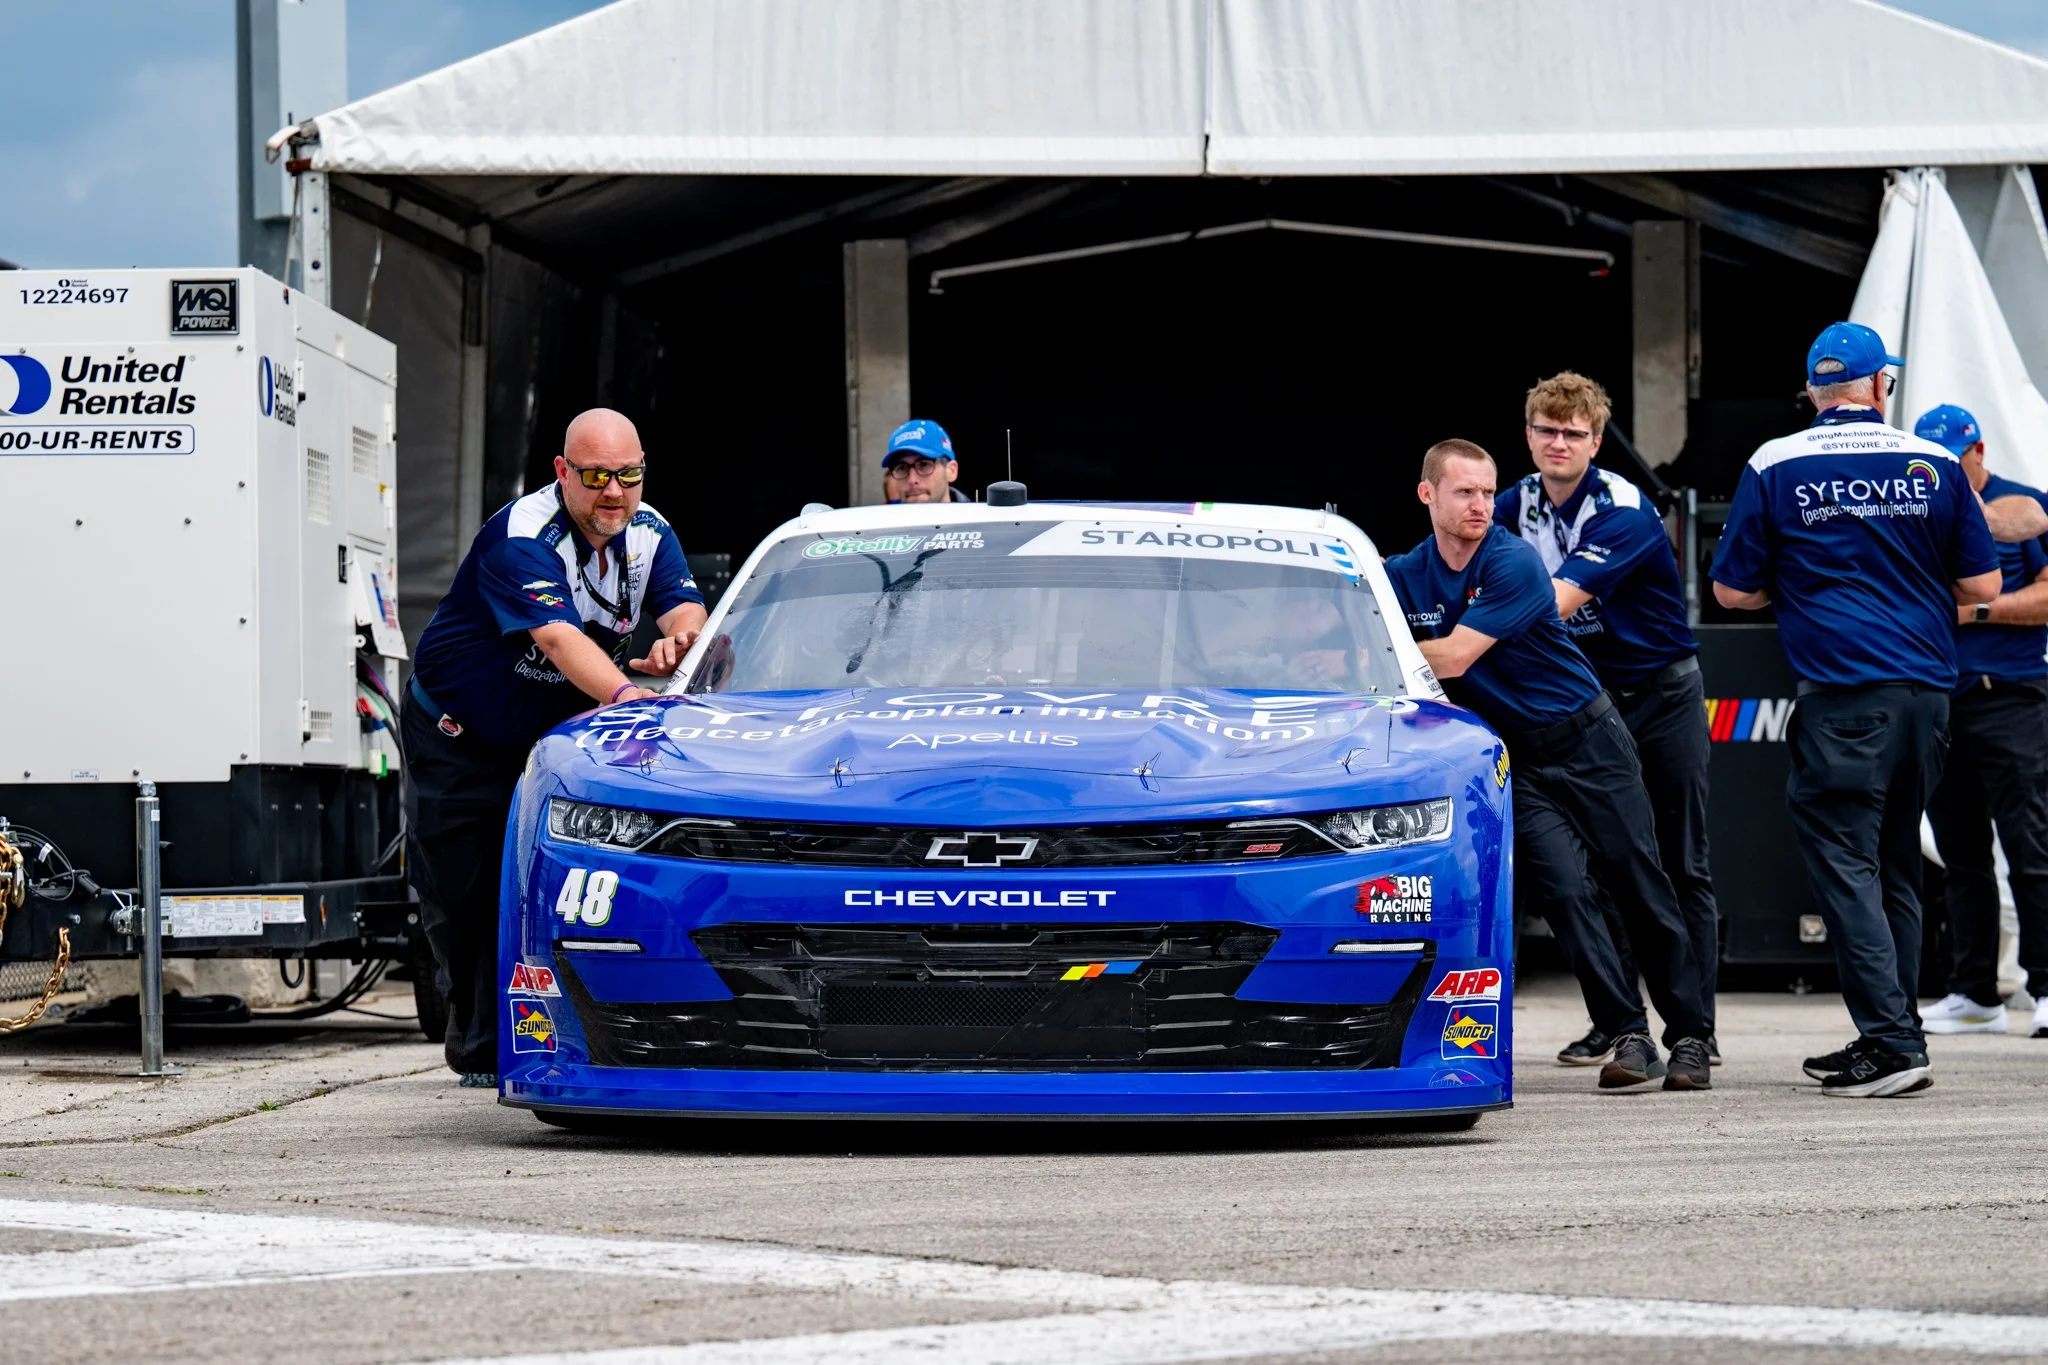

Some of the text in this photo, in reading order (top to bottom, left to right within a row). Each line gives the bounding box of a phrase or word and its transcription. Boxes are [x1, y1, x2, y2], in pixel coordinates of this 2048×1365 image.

[20, 288, 129, 304] 12224697
[179, 316, 230, 329] POWER
[61, 355, 186, 383] United
[59, 387, 196, 415] Rentals
[0, 430, 183, 449] 00-UR-RENTS
[1807, 430, 1906, 442] @BigMachineRacing
[1821, 441, 1900, 451] @SYFOVRE_US
[1795, 478, 1928, 507] SYFOVRE
[1880, 500, 1929, 518] injection)
[923, 540, 985, 550] PARTS
[932, 531, 982, 541] AUTO
[1081, 530, 1320, 557] STAROPOLI
[803, 536, 923, 558] O'Reilly
[575, 704, 1315, 748] (pegcetacoplan injection)
[886, 731, 1079, 749] Apellis
[1396, 876, 1432, 898] BIG
[555, 868, 619, 926] 48
[844, 890, 1116, 906] CHEVROLET
[1370, 899, 1432, 913] MACHINE
[1370, 913, 1432, 923] RACING
[511, 964, 554, 991] ARP
[1432, 970, 1500, 996] ARP
[518, 1020, 554, 1034] SUNOCO
[1445, 1025, 1492, 1040] SUNOCO
